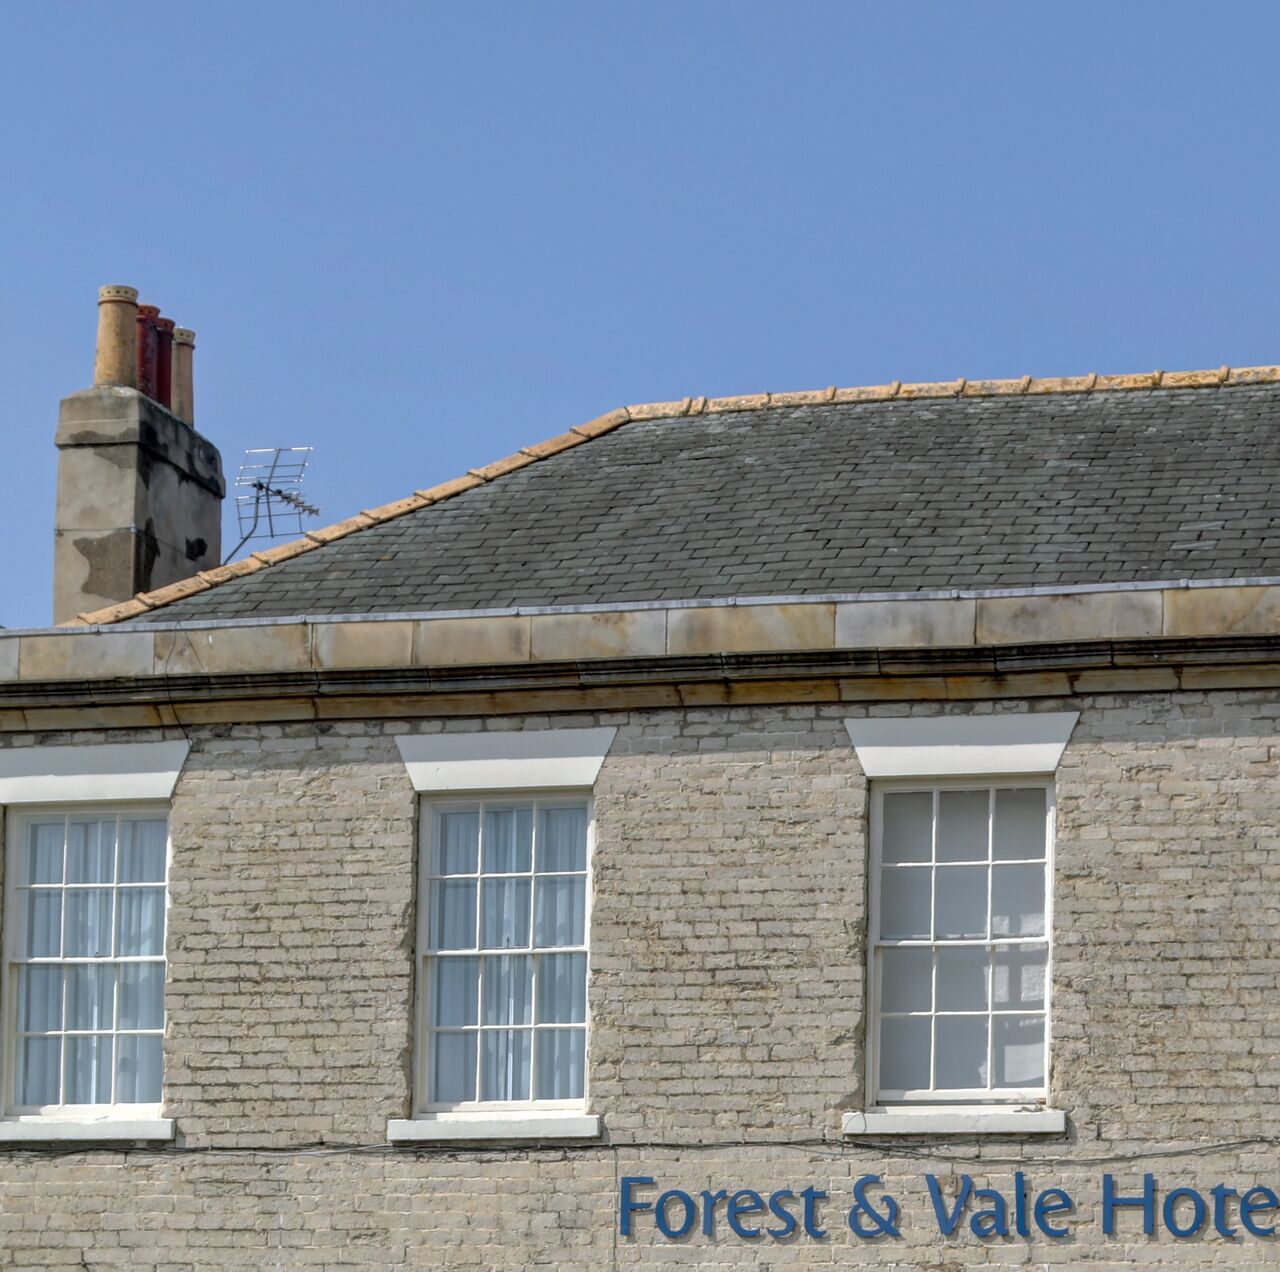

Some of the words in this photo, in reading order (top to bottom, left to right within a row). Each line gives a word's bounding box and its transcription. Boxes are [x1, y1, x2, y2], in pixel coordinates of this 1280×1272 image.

[619, 1175, 826, 1238] Forest
[848, 1173, 900, 1237] &
[926, 1172, 1072, 1237] Vale
